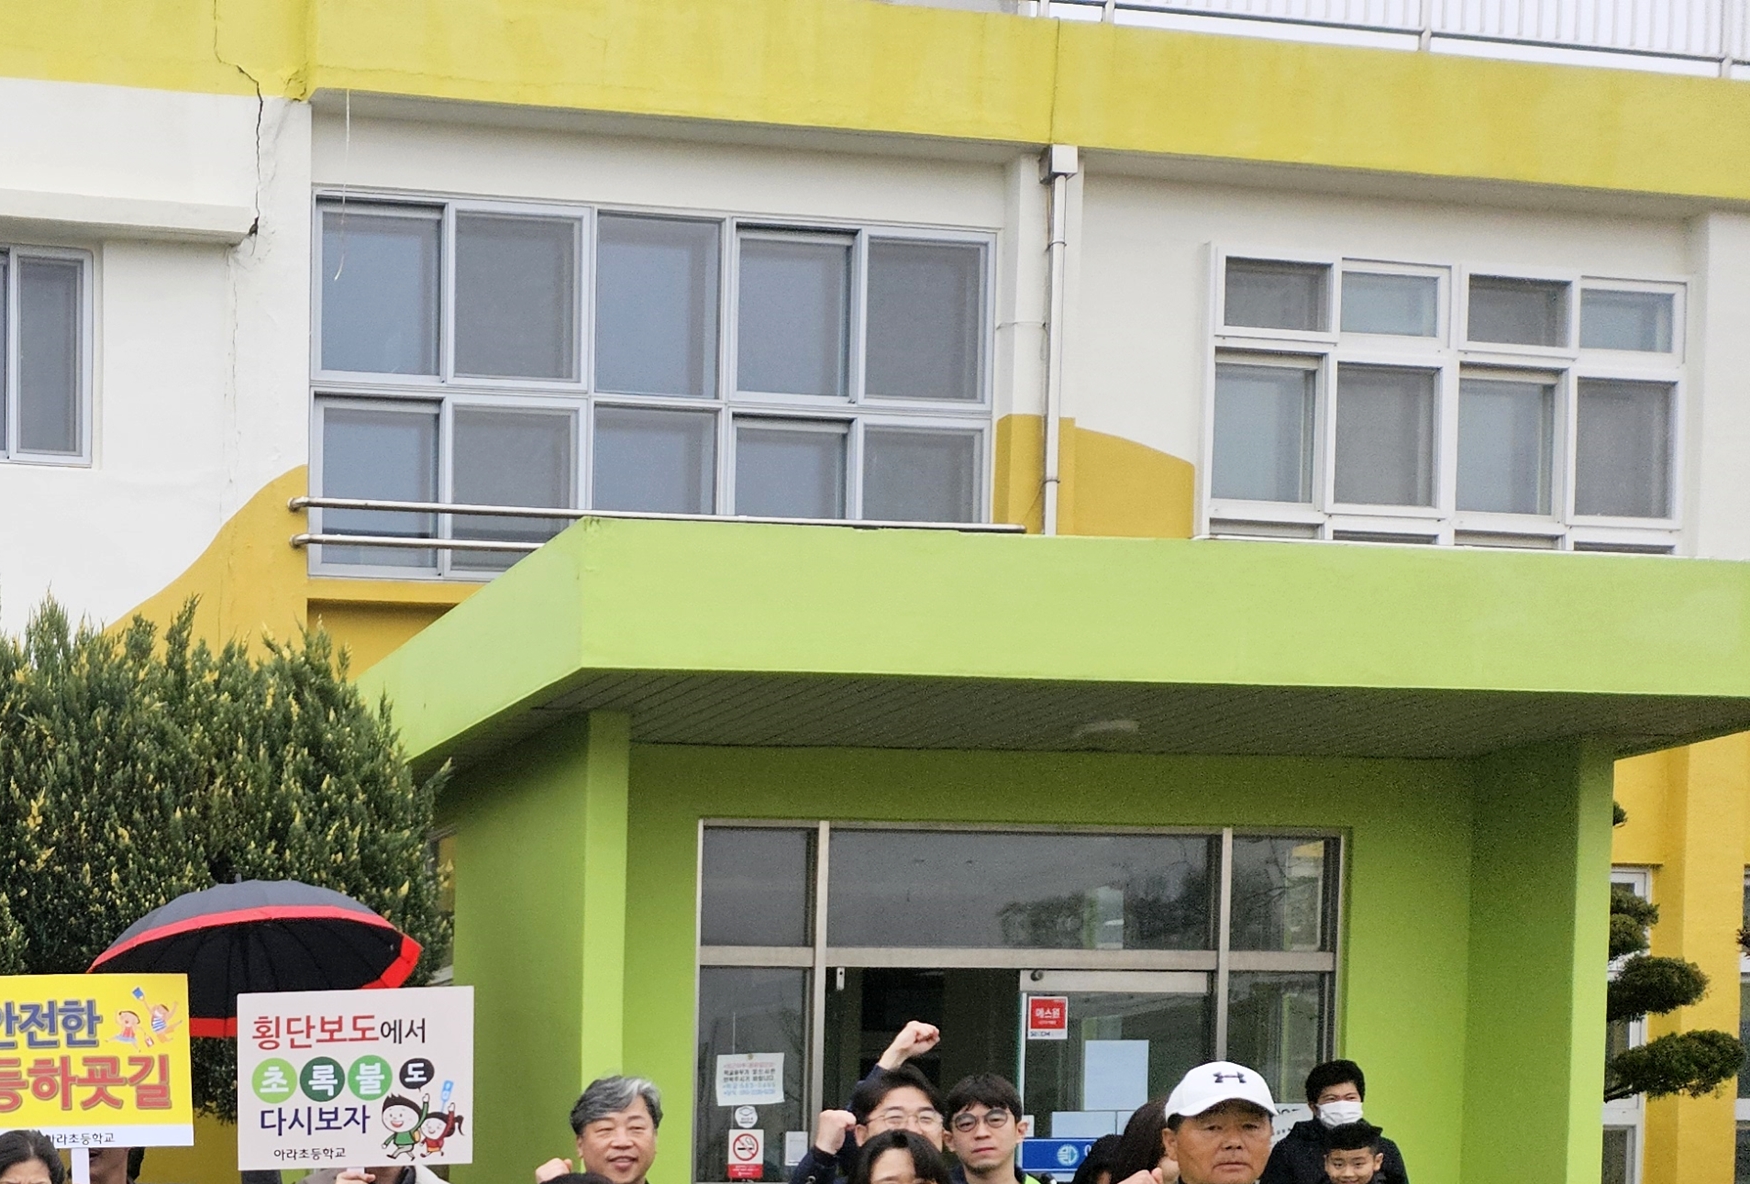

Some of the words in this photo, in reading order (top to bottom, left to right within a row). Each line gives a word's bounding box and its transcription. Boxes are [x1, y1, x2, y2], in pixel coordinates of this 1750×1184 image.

[252, 1015, 427, 1051] 횡단보도에서
[260, 1104, 371, 1137] 다시보자
[273, 1147, 347, 1162] 아라초등학교
